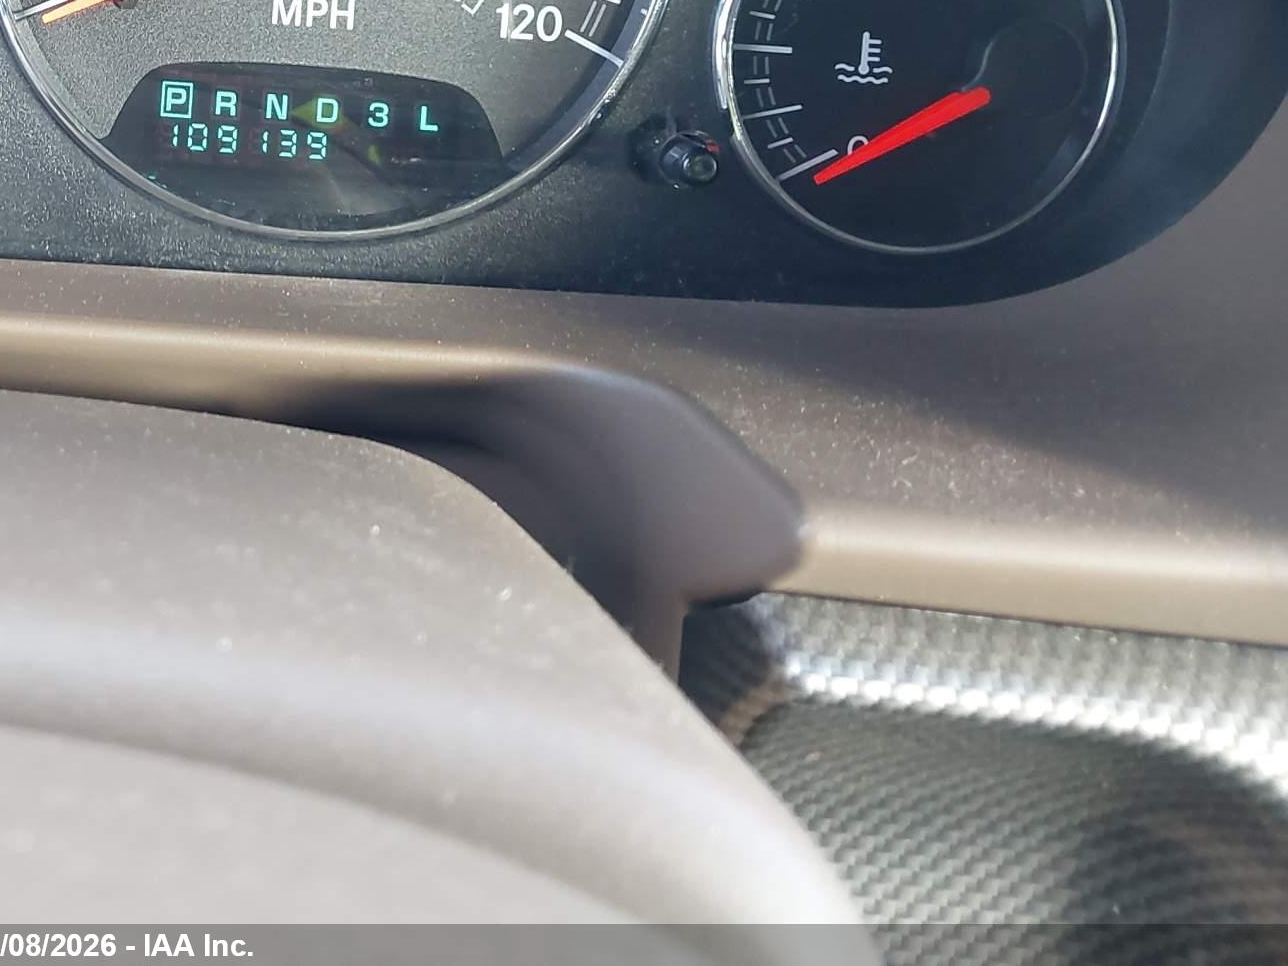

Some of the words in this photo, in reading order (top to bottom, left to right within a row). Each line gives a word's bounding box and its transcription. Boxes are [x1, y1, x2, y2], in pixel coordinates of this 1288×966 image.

[495, 3, 563, 42] 120
[166, 88, 187, 111] P
[215, 91, 237, 116] R
[265, 94, 288, 120] N
[316, 98, 339, 123] D
[368, 103, 389, 127] 3
[419, 106, 439, 131] L
[172, 123, 328, 160] 109139
